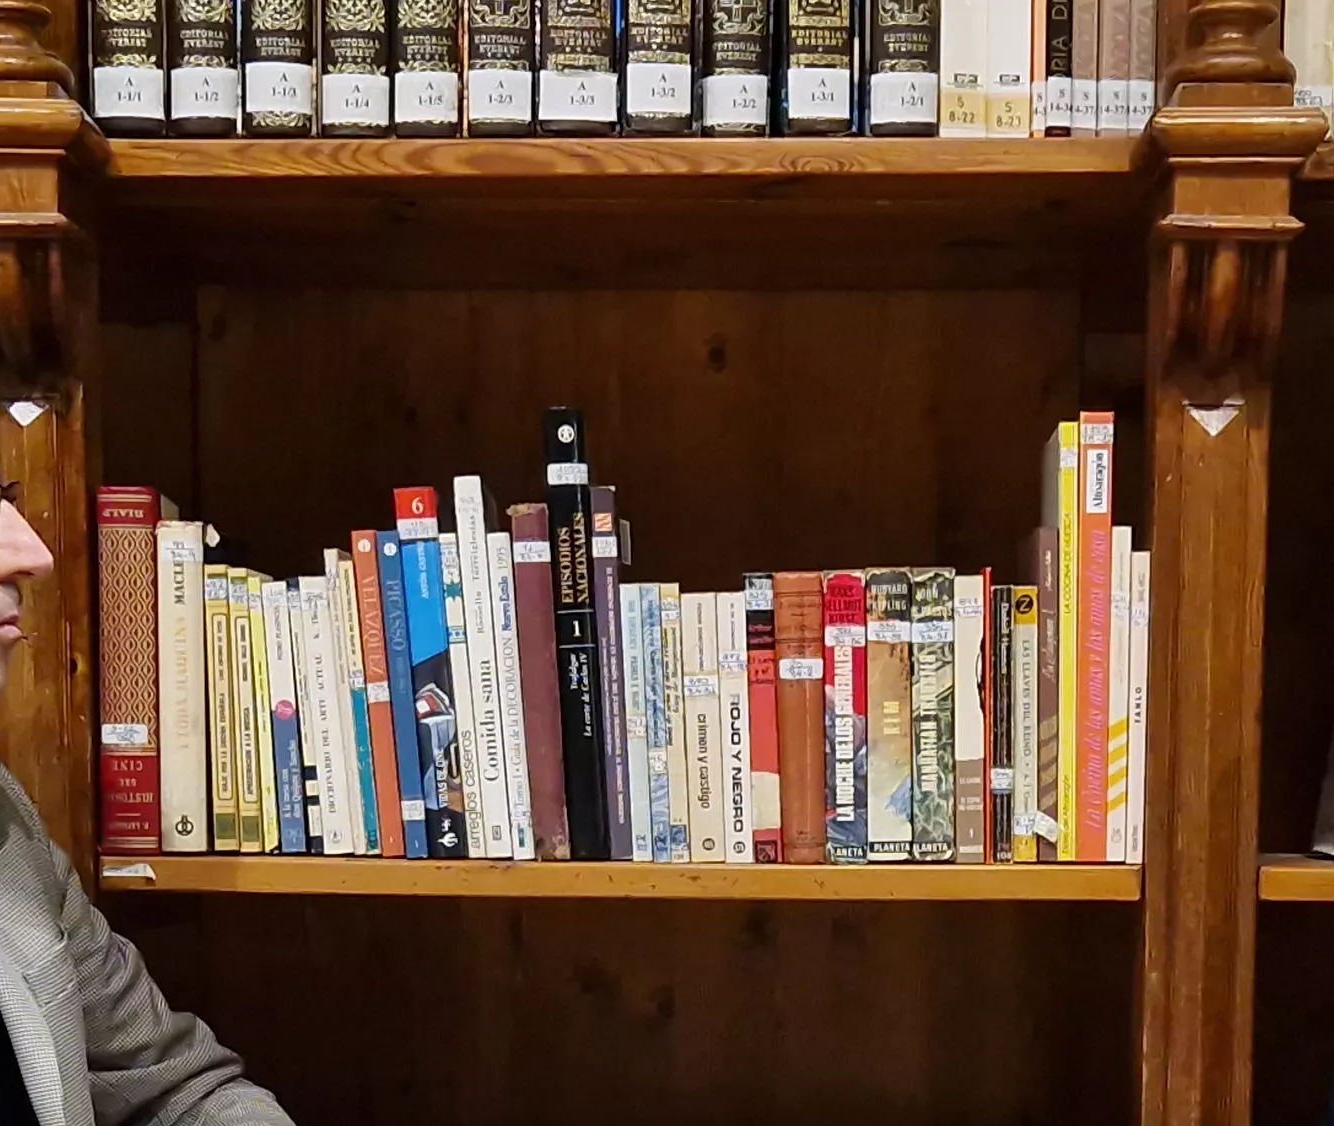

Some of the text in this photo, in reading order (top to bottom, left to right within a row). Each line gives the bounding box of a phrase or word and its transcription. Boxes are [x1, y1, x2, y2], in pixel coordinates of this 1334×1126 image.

[123, 76, 134, 87] A
[201, 77, 211, 88] A
[279, 73, 289, 84] A
[658, 73, 667, 83] A
[818, 78, 827, 88] A
[352, 84, 362, 94] A
[425, 80, 435, 90] A
[496, 79, 506, 90] A
[578, 81, 587, 91] A
[739, 84, 748, 94] A
[908, 82, 917, 92] A
[117, 91, 142, 102] 1-1/1
[194, 91, 219, 102] 1-1/2
[271, 87, 297, 97] 1-1/3
[650, 87, 676, 98] 1-3/2
[811, 92, 835, 102] 1-3/1
[344, 98, 370, 109] 1-1/4
[418, 94, 444, 105] 1-1/5
[488, 94, 513, 104] 1-2/3
[570, 95, 596, 106] 1-3/3
[732, 98, 757, 109] 1-2/2
[900, 96, 925, 106] 1-2/1
[958, 96, 964, 108] S
[1005, 104, 1011, 112] S
[411, 496, 424, 515] 6
[1093, 529, 1106, 562] casa
[572, 511, 589, 603] NACIONALES
[557, 526, 574, 602] EPISODIOS
[1088, 569, 1105, 583] de
[383, 577, 408, 652] PICASSO
[359, 573, 386, 676] VELAZQUEZ
[572, 620, 582, 637] 1
[1087, 631, 1104, 649] los
[1091, 654, 1106, 664] y
[1021, 640, 1031, 757] LAS LLAVES DEL REINO
[1133, 685, 1142, 723] FANLO
[478, 659, 500, 782] Comida sana
[1086, 710, 1105, 728] las
[834, 645, 854, 821] LA NOCHE DE LOS GENERALES
[1085, 736, 1104, 748] de
[729, 693, 744, 832] ROJO Y NEGRO
[1083, 754, 1104, 805] Cocina
[460, 729, 483, 850] arreglos caseros
[696, 766, 712, 808] castigo
[1085, 809, 1101, 828] La
[873, 842, 911, 852] PLANETA
